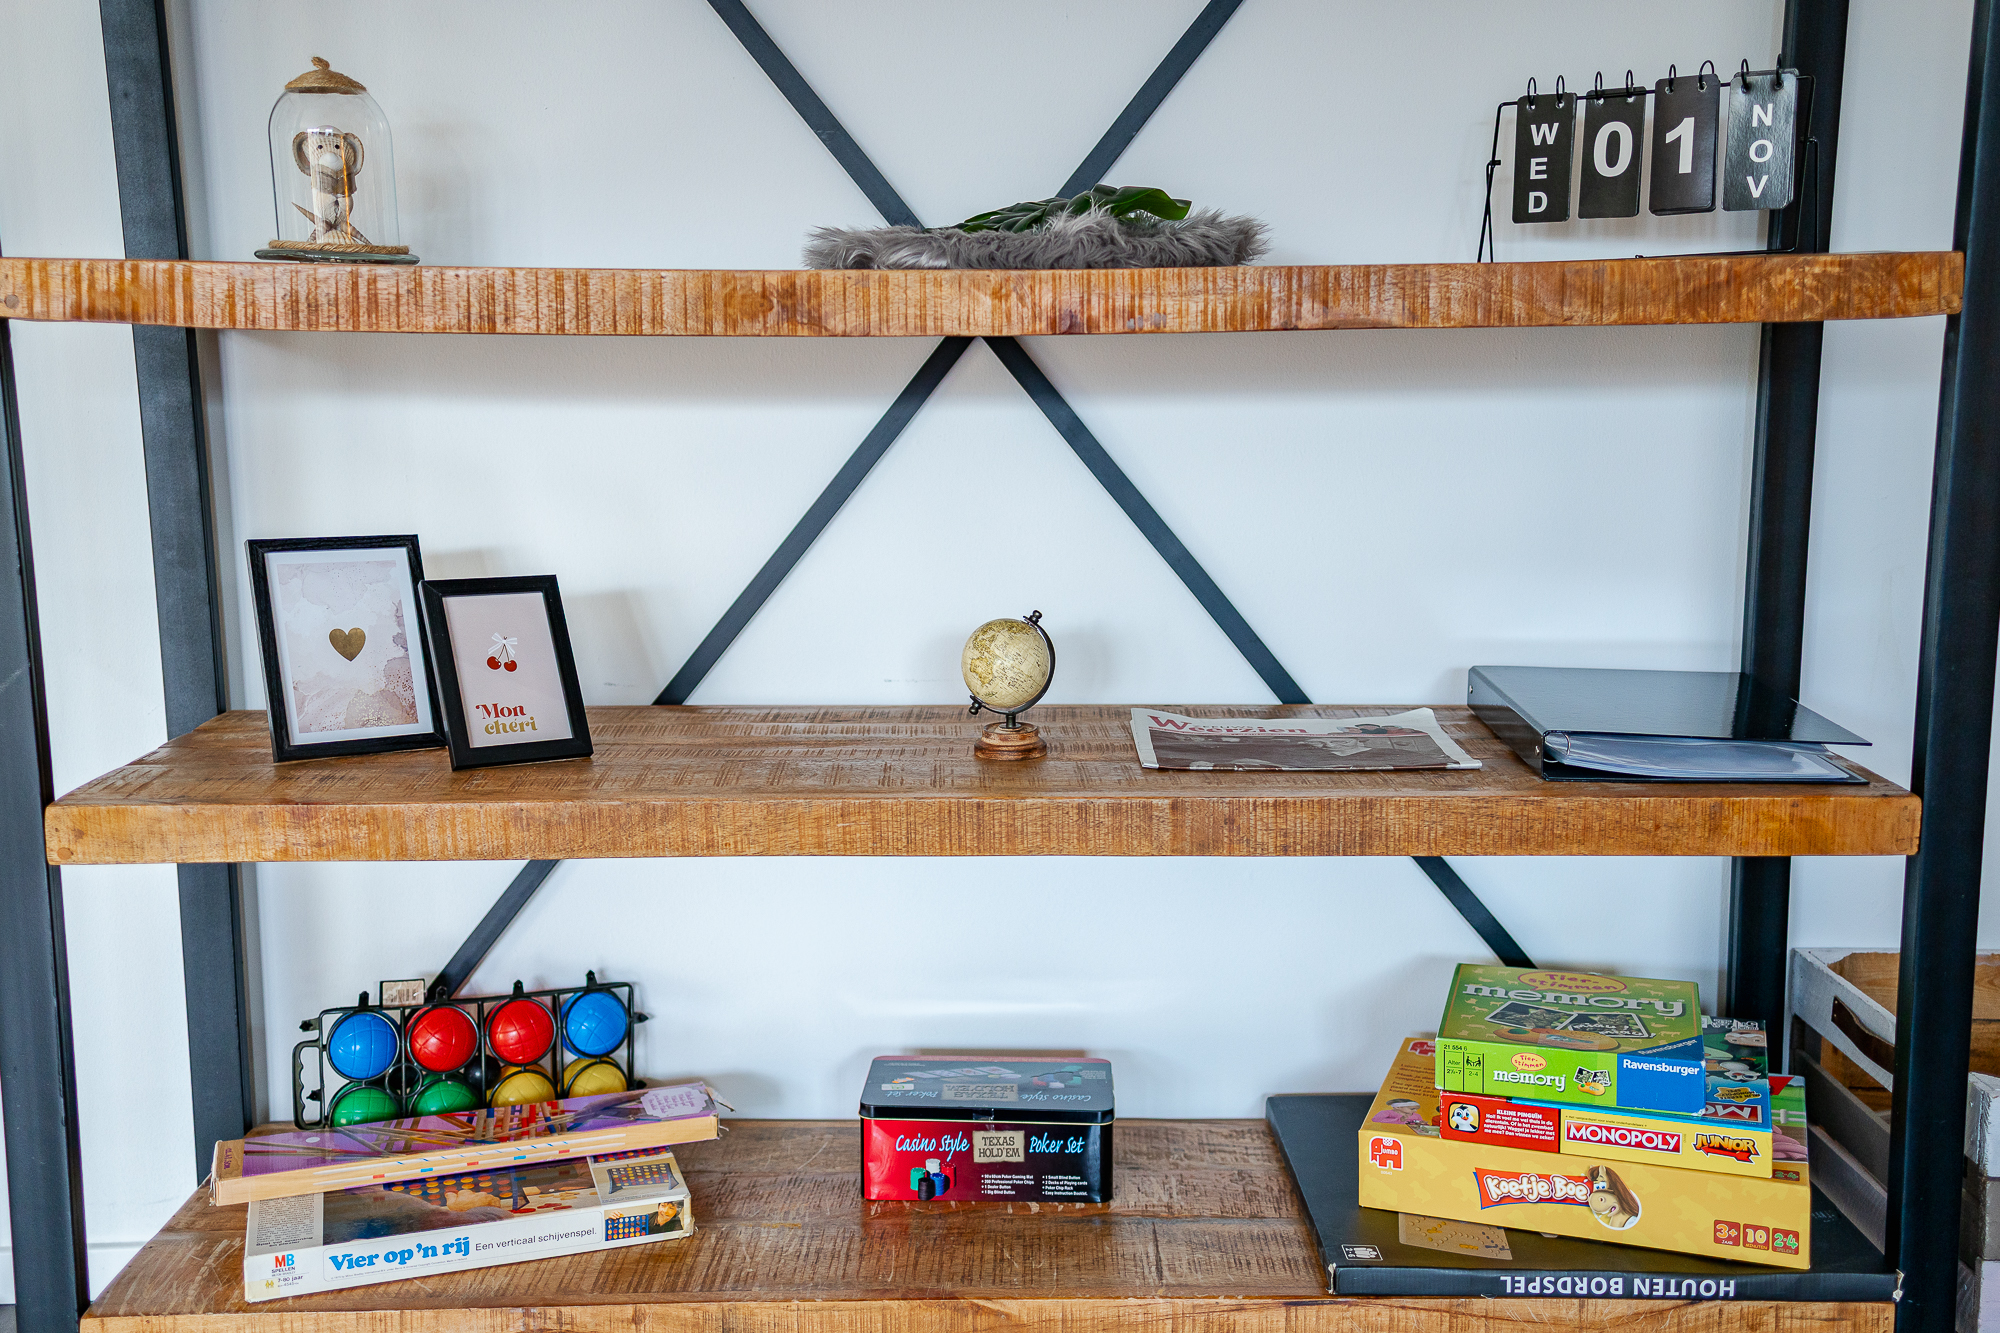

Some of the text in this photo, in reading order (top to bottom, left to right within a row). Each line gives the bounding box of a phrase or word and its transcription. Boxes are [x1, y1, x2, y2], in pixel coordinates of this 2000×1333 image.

[1528, 103, 1773, 214] WED 0 1 NOV
[475, 702, 527, 720] Mon
[484, 716, 538, 735] chéri
[1147, 714, 1310, 734] Weerzien
[1528, 977, 1618, 992] stimmen
[1462, 983, 1686, 1017] memory
[1637, 1039, 1698, 1055] Ravensburger
[1514, 1059, 1544, 1068] stimmen
[1622, 1058, 1700, 1076] Ravensburger
[1493, 1069, 1566, 1092] memory
[905, 1091, 939, 1099] Poker
[1020, 1090, 1092, 1102] Casino Style
[981, 1136, 1015, 1147] TEXAS
[1028, 1132, 1086, 1154] Poker Set
[1569, 1123, 1679, 1150] MONOPOLY
[1695, 1134, 1760, 1155] JUNIOR
[895, 1131, 971, 1162] Casino Style
[978, 1147, 1021, 1158] HOLD'EM
[1774, 1171, 1799, 1180] 2-4
[1485, 1174, 1590, 1202] Koetje Boe
[475, 1228, 597, 1251] Een verticaal schijvenspel.
[1716, 1224, 1738, 1238] 3+
[1746, 1228, 1767, 1244] 10
[1774, 1233, 1798, 1249] 2-4
[274, 1254, 295, 1268] MB
[328, 1253, 380, 1271] Vier
[384, 1248, 414, 1265] op
[442, 1236, 470, 1256] rij
[1500, 1276, 1736, 1298] HOUTEN BORDSPEL
